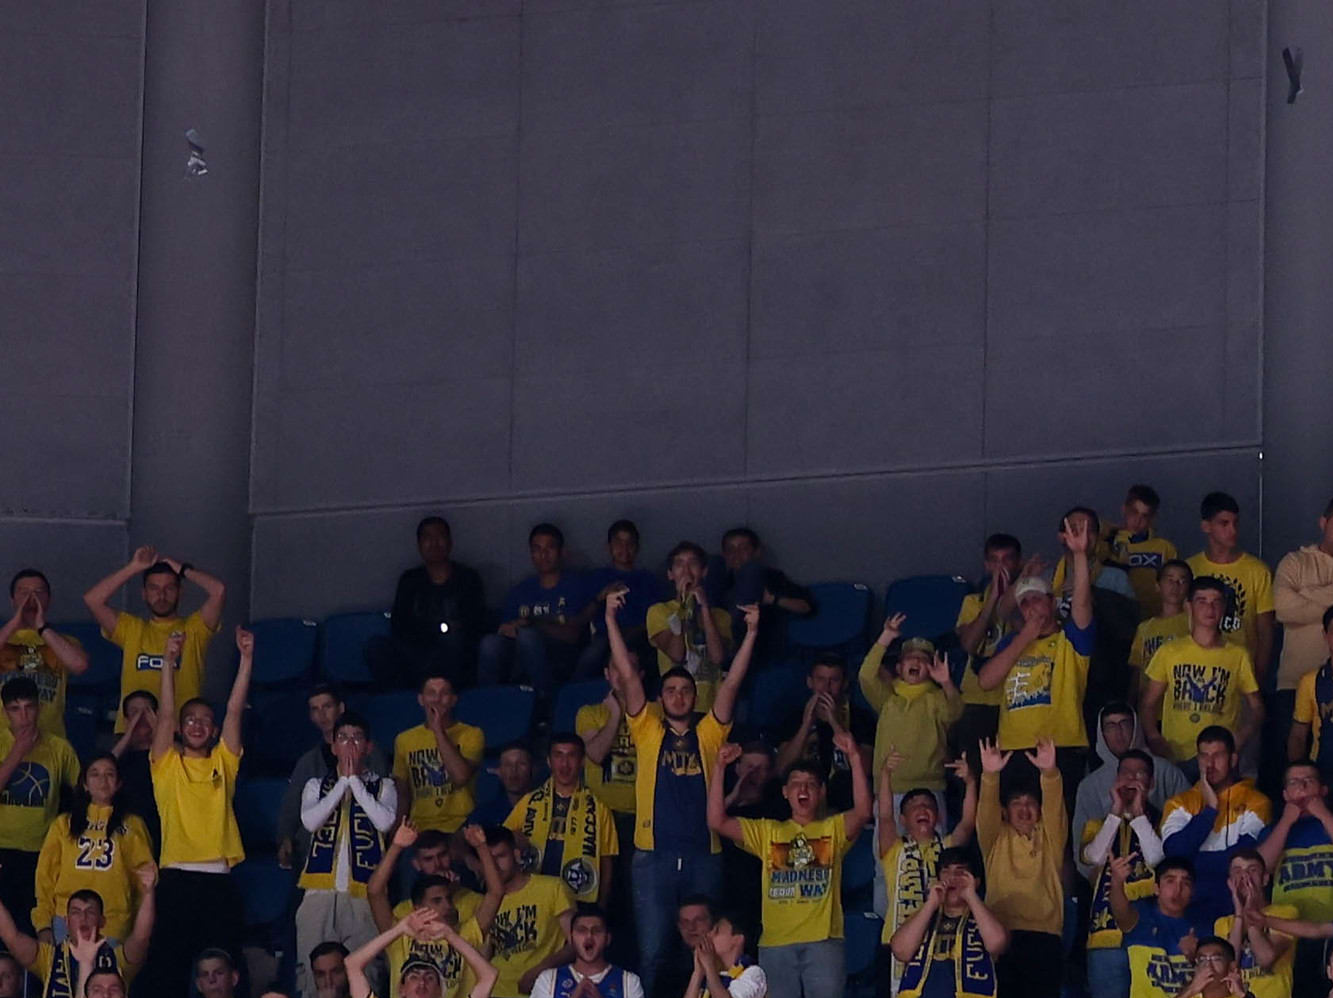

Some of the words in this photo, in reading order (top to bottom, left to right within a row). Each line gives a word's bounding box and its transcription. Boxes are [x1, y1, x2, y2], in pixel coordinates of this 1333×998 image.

[1128, 551, 1162, 568] OX
[661, 750, 703, 776] MTA
[75, 837, 114, 870] 23
